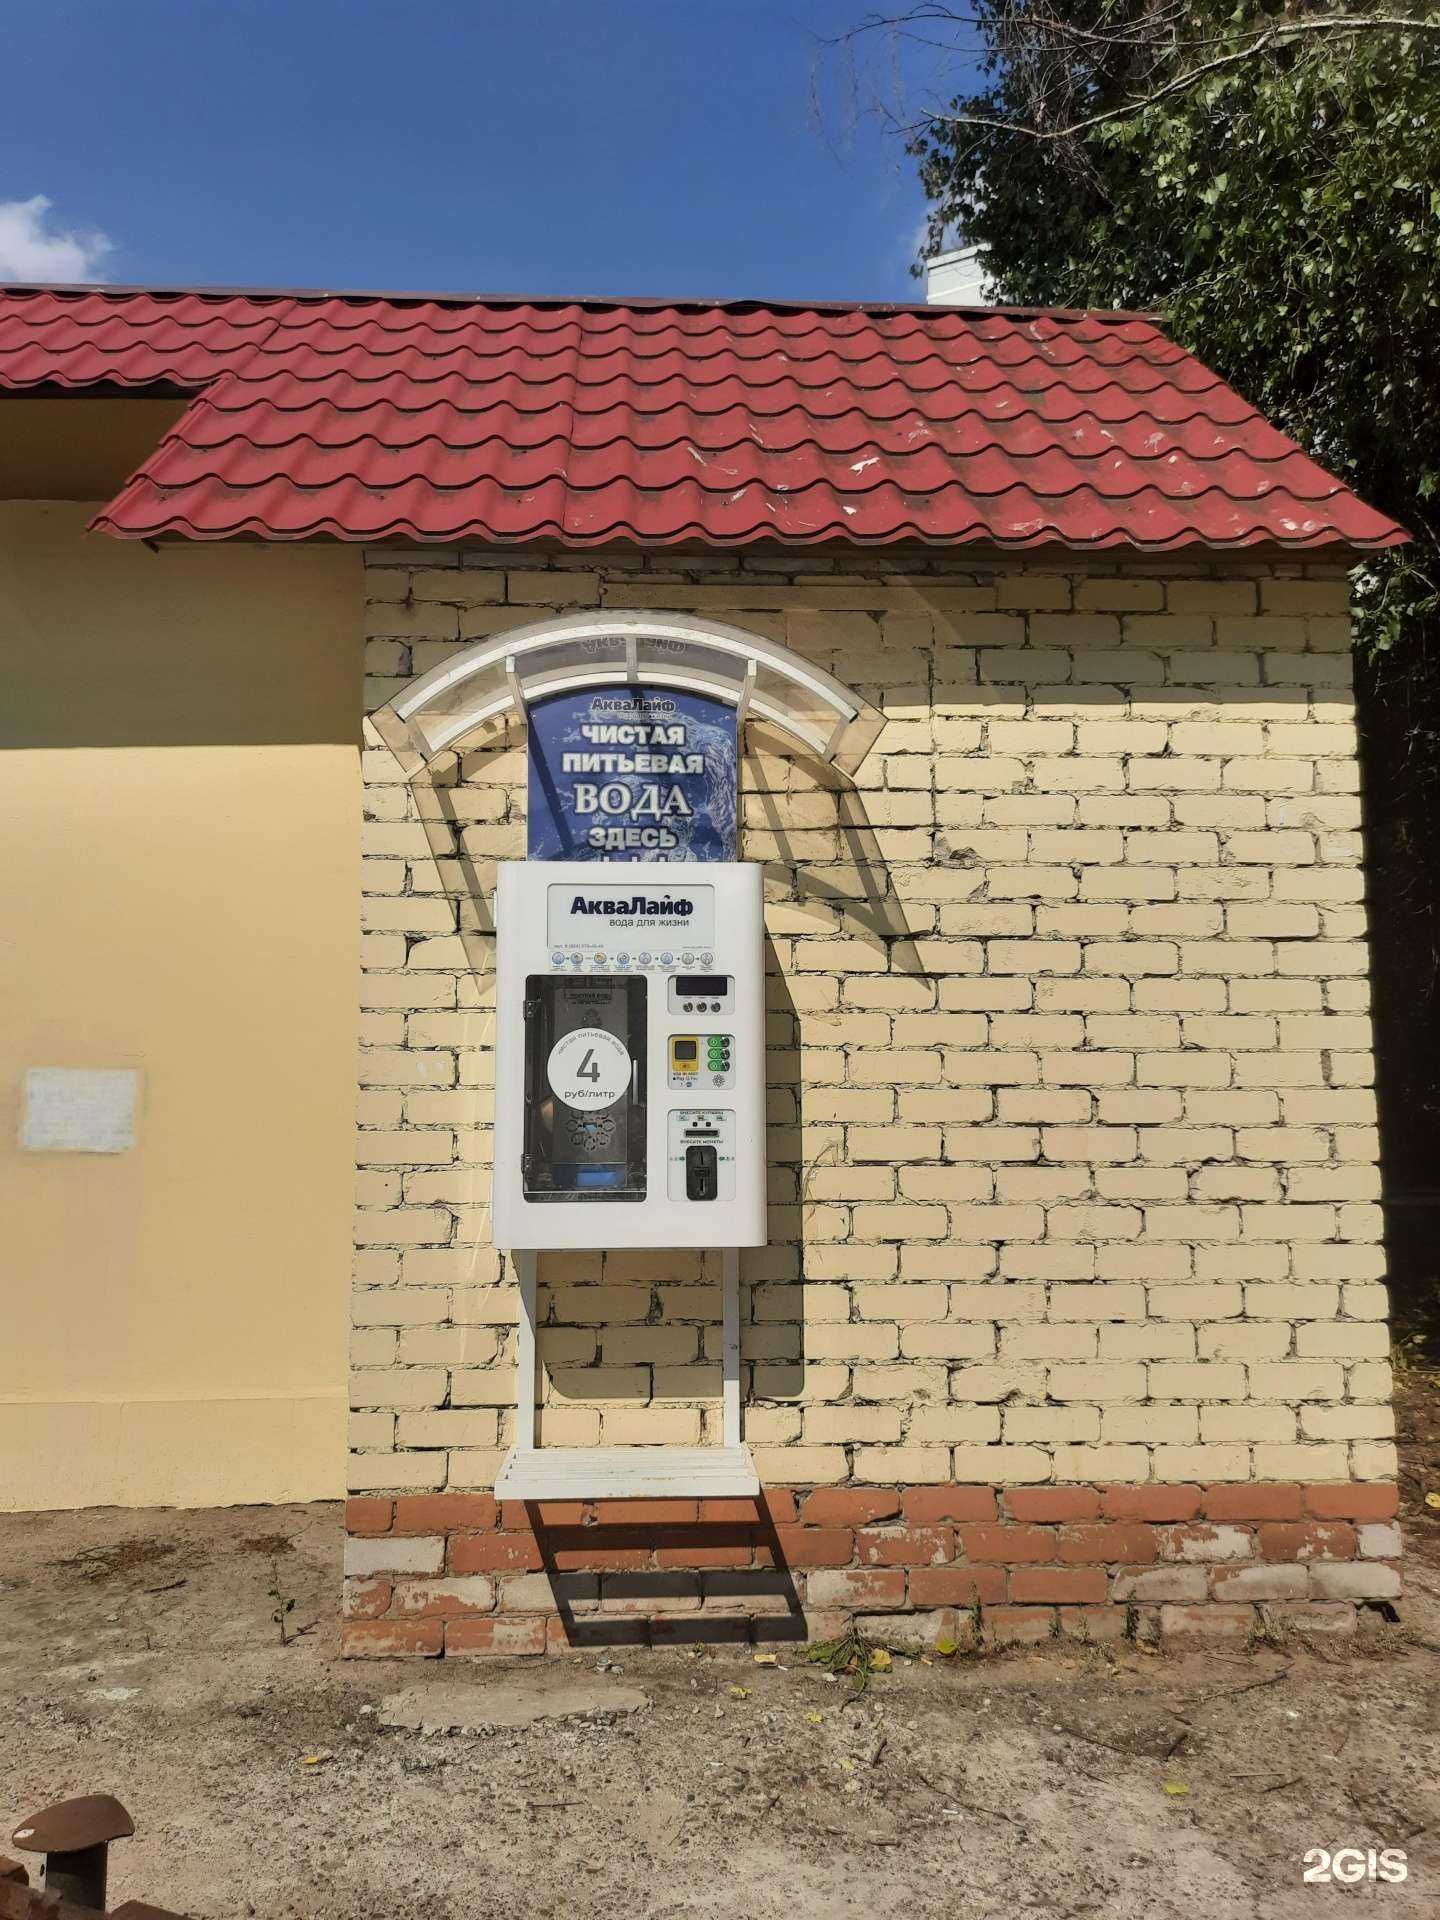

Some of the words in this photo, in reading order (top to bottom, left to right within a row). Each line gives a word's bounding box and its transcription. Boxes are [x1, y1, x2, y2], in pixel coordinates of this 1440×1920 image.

[591, 697, 676, 712] АкваЛайф
[582, 725, 686, 745] ЧИСТАЯ
[562, 753, 704, 774] ПИТЬЕВАЯ
[573, 783, 693, 820] ВОДА
[588, 828, 679, 850] ЗДЕСЬ
[570, 894, 694, 916] АкваЛайф
[609, 918, 634, 928] вода
[637, 918, 656, 928] для
[659, 918, 690, 927] жизни
[577, 1049, 601, 1082] 4
[565, 1089, 616, 1099] руб/литр
